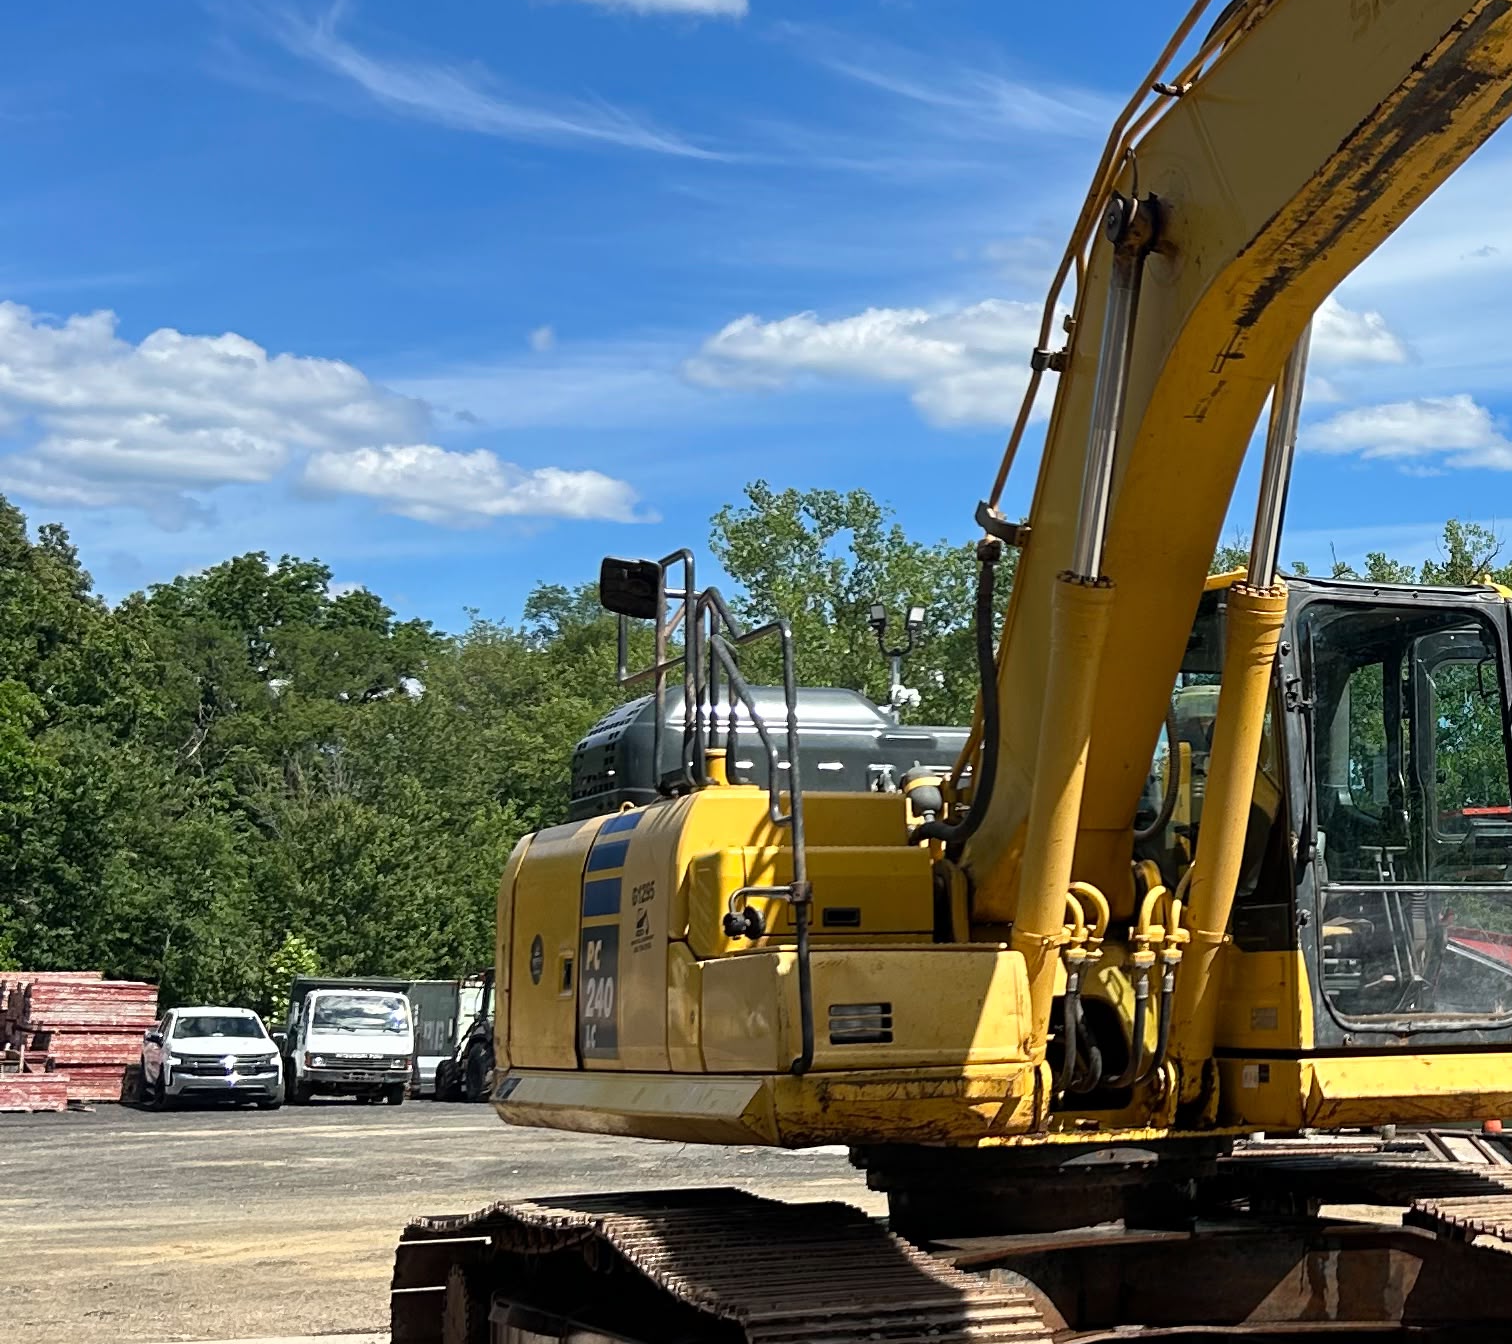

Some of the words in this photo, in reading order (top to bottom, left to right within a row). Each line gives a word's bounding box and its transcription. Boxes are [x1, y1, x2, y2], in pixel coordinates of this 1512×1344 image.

[585, 940, 603, 971] PC
[585, 976, 614, 1018] 240
[585, 1023, 597, 1049] LC
